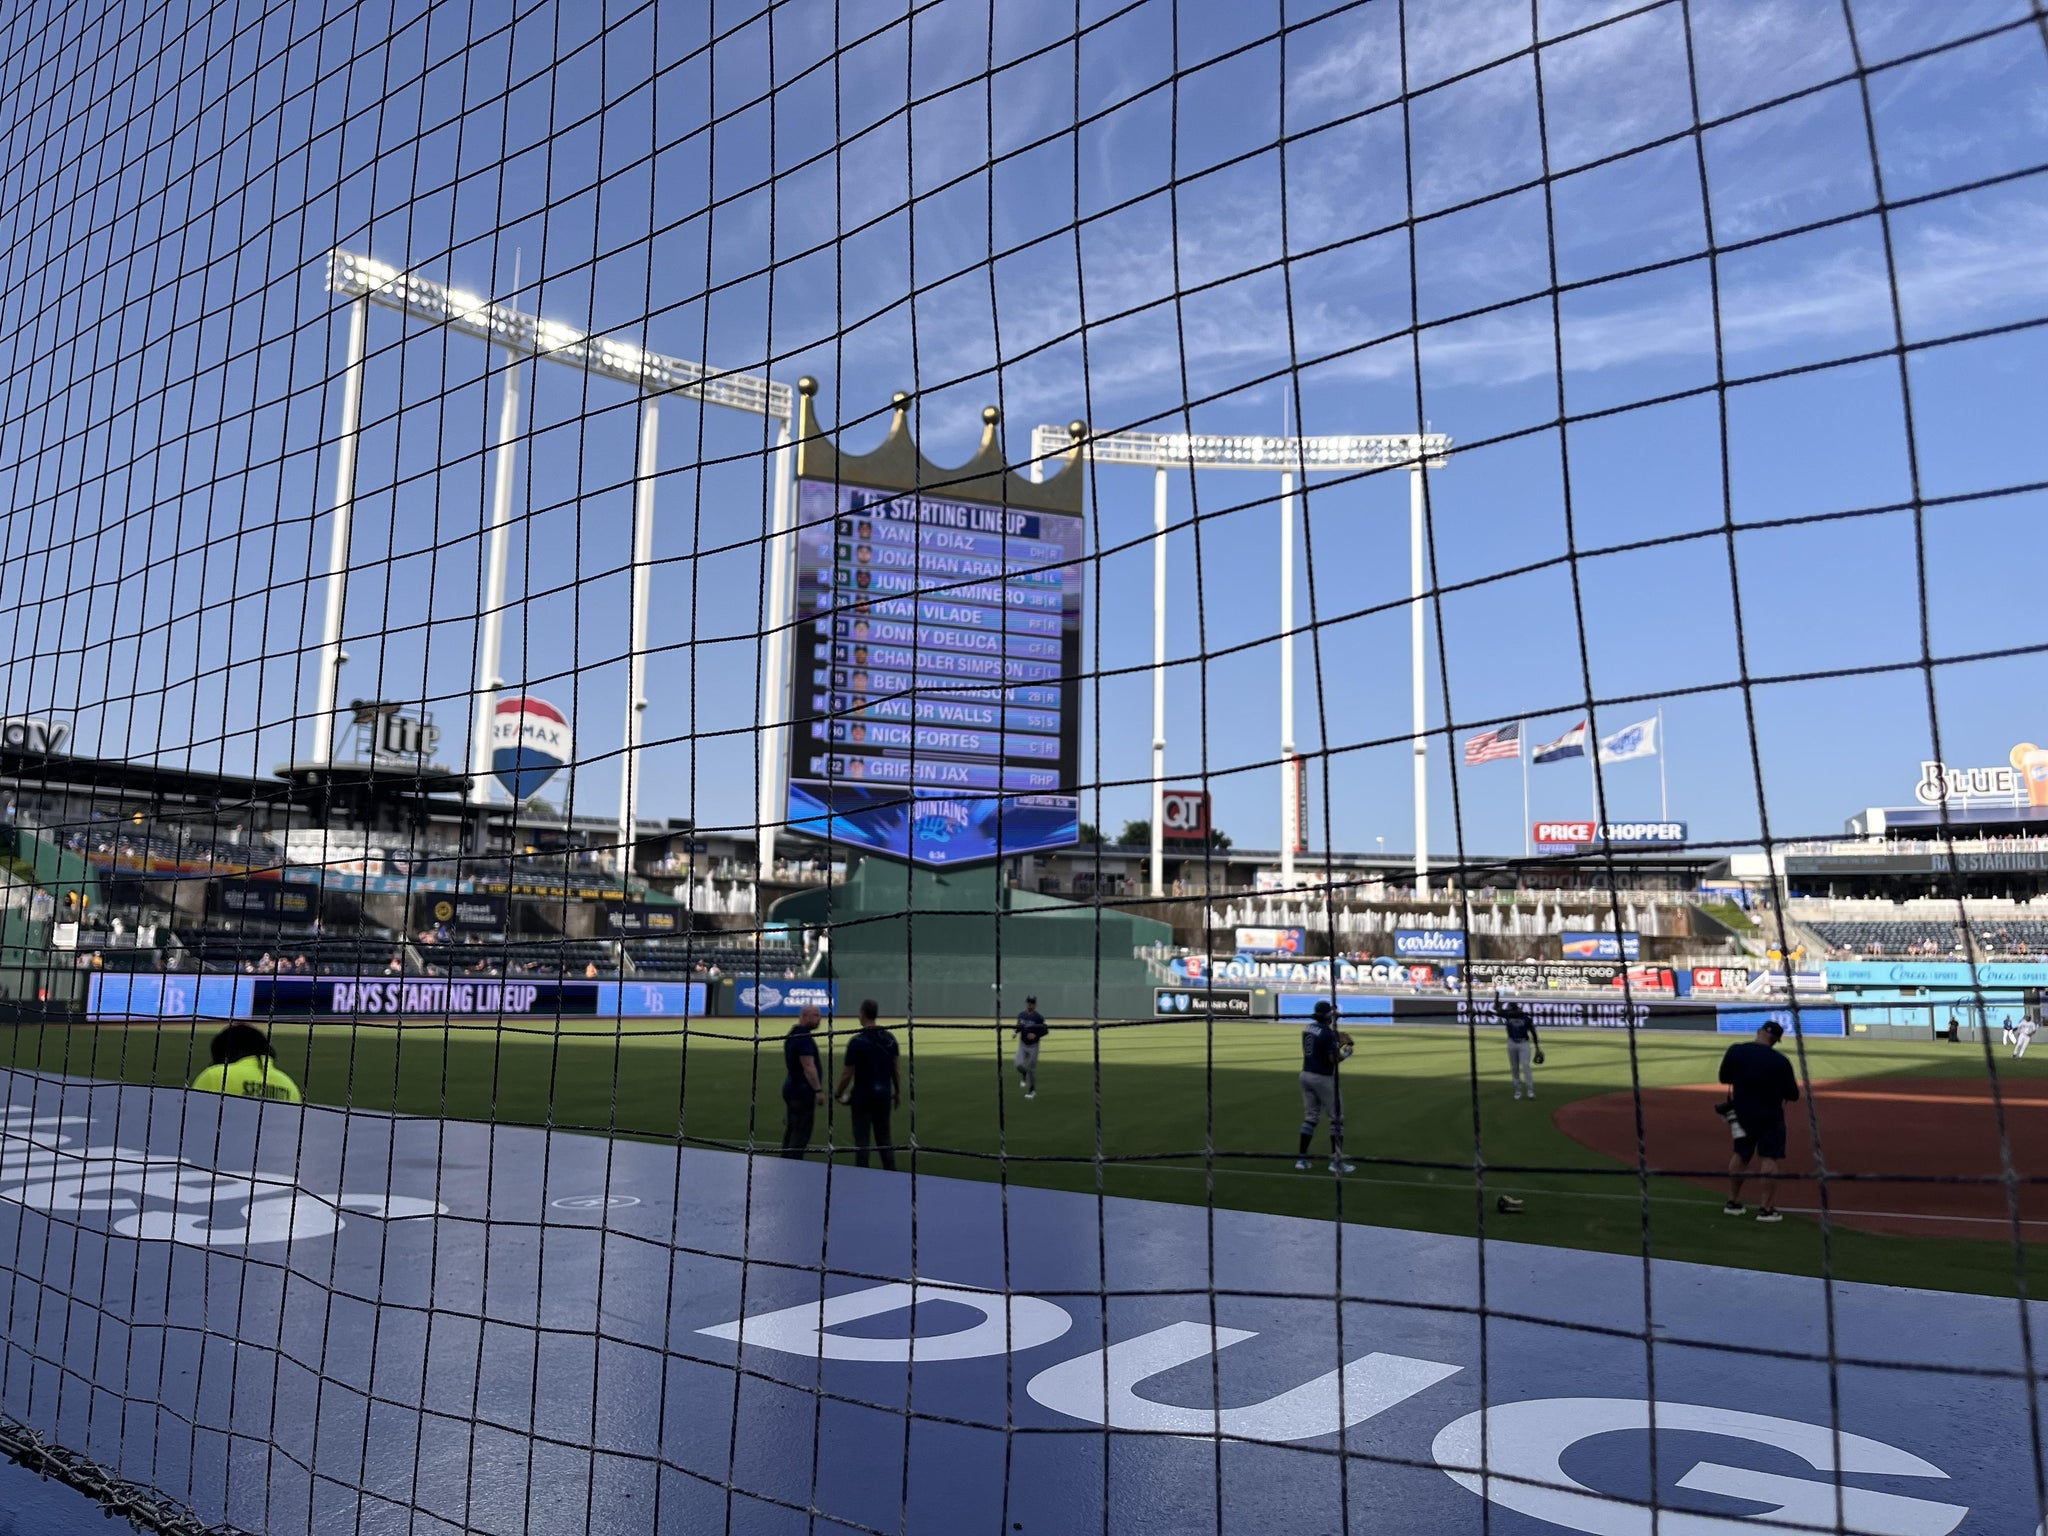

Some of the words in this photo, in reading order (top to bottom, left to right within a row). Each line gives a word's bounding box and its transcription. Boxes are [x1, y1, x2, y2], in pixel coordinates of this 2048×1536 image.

[890, 498, 968, 528] STARTING
[970, 507, 1027, 535] LINEUP
[878, 525, 932, 544] YANDY
[876, 550, 958, 573] JONATHAN
[940, 582, 1025, 605] CAMINERO
[875, 601, 917, 617] RYAN
[923, 604, 982, 625] VILADE
[875, 625, 929, 643] JONNY
[933, 631, 998, 650] DELUCA
[873, 650, 954, 671] CHANDLER
[957, 657, 1023, 678] SIMPSON
[873, 675, 908, 690] BEN
[874, 700, 935, 719] TAYLOR
[939, 706, 993, 723] WALLS
[871, 727, 912, 744] NICK
[915, 731, 980, 749] FORTES
[870, 761, 937, 780] GRIFFIN
[940, 767, 969, 782] JAX
[1029, 773, 1054, 785] RHP
[1917, 763, 2012, 803] BLUE
[1162, 794, 1203, 831] QT
[1538, 824, 1590, 841] PRICE
[1598, 823, 1683, 840] CHOPPER
[1932, 853, 1968, 872] RAS
[1969, 853, 2036, 870] STARTING
[1396, 931, 1464, 951] carbliss
[1212, 961, 1331, 981] FOUNTAIN
[1340, 964, 1406, 982] DECK
[1463, 965, 1500, 976] GREAT
[1501, 966, 1537, 977] VIEWS
[1544, 966, 1580, 977] FRESH
[1582, 967, 1615, 978] FOOD
[332, 983, 383, 1014] RAYS
[384, 983, 473, 1014] STARTING
[476, 984, 538, 1014] LINEUP
[788, 987, 827, 997] OFFICIAL
[1228, 999, 1249, 1012] City
